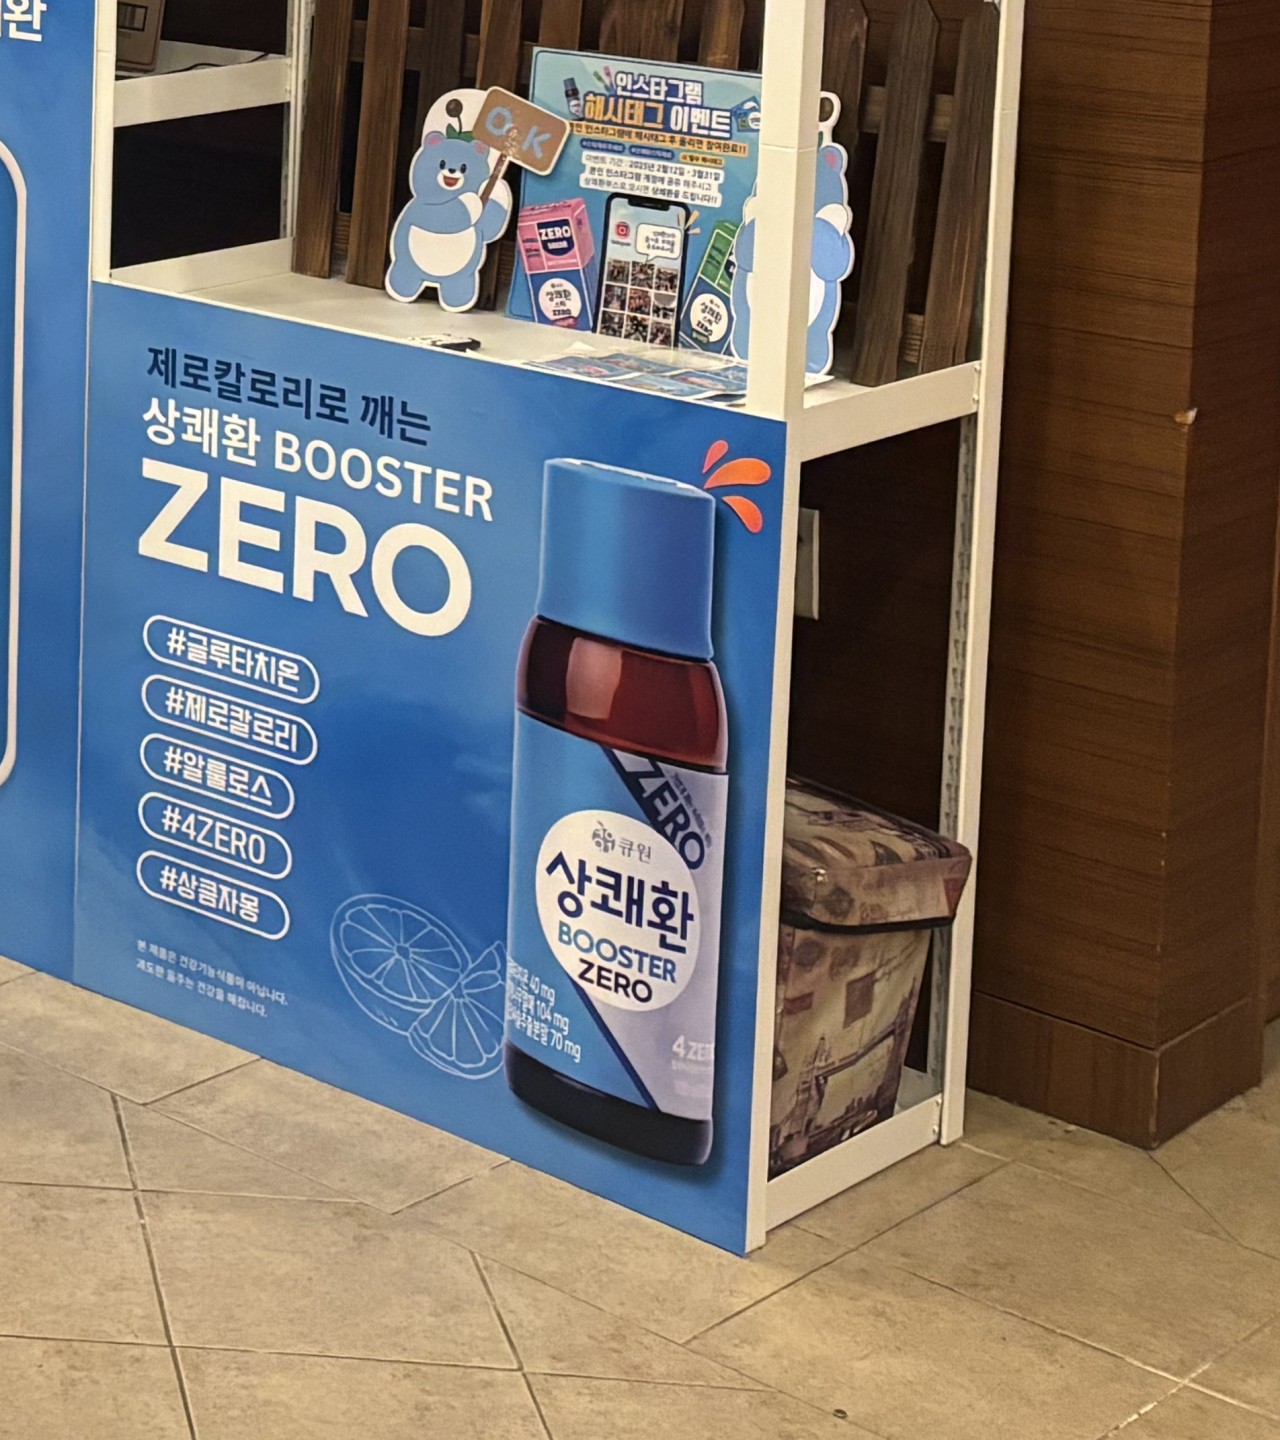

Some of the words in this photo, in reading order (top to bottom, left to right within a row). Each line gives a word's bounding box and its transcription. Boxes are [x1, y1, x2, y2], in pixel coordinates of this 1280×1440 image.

[584, 93, 665, 130] 해시태그
[670, 104, 731, 138] 이벤트
[616, 71, 703, 106] 인스타그램
[538, 225, 572, 241] ZERO
[146, 346, 350, 425] 제로칼로리로
[360, 394, 432, 447] 깨는
[142, 397, 261, 468] 상쾌환
[274, 430, 493, 522] BOOSTER
[138, 456, 473, 637] ZERO
[166, 627, 300, 693] #글루타치온
[164, 686, 298, 753] #제로칼로리
[163, 746, 273, 807] #알룰로스
[161, 804, 266, 866] #4ZERO
[620, 756, 705, 870] ZERO
[618, 838, 652, 864] 큐원
[159, 864, 261, 924] #상큼자몽
[546, 850, 694, 955] 상쾌환
[558, 920, 677, 984] BOOSTER
[577, 957, 653, 1004] ZERO
[536, 1000, 552, 1022] 104
[553, 1012, 569, 1036] mg
[541, 984, 556, 1006] mg
[550, 1028, 563, 1050] 70
[564, 1039, 582, 1063] mg
[672, 1035, 686, 1058] 4
